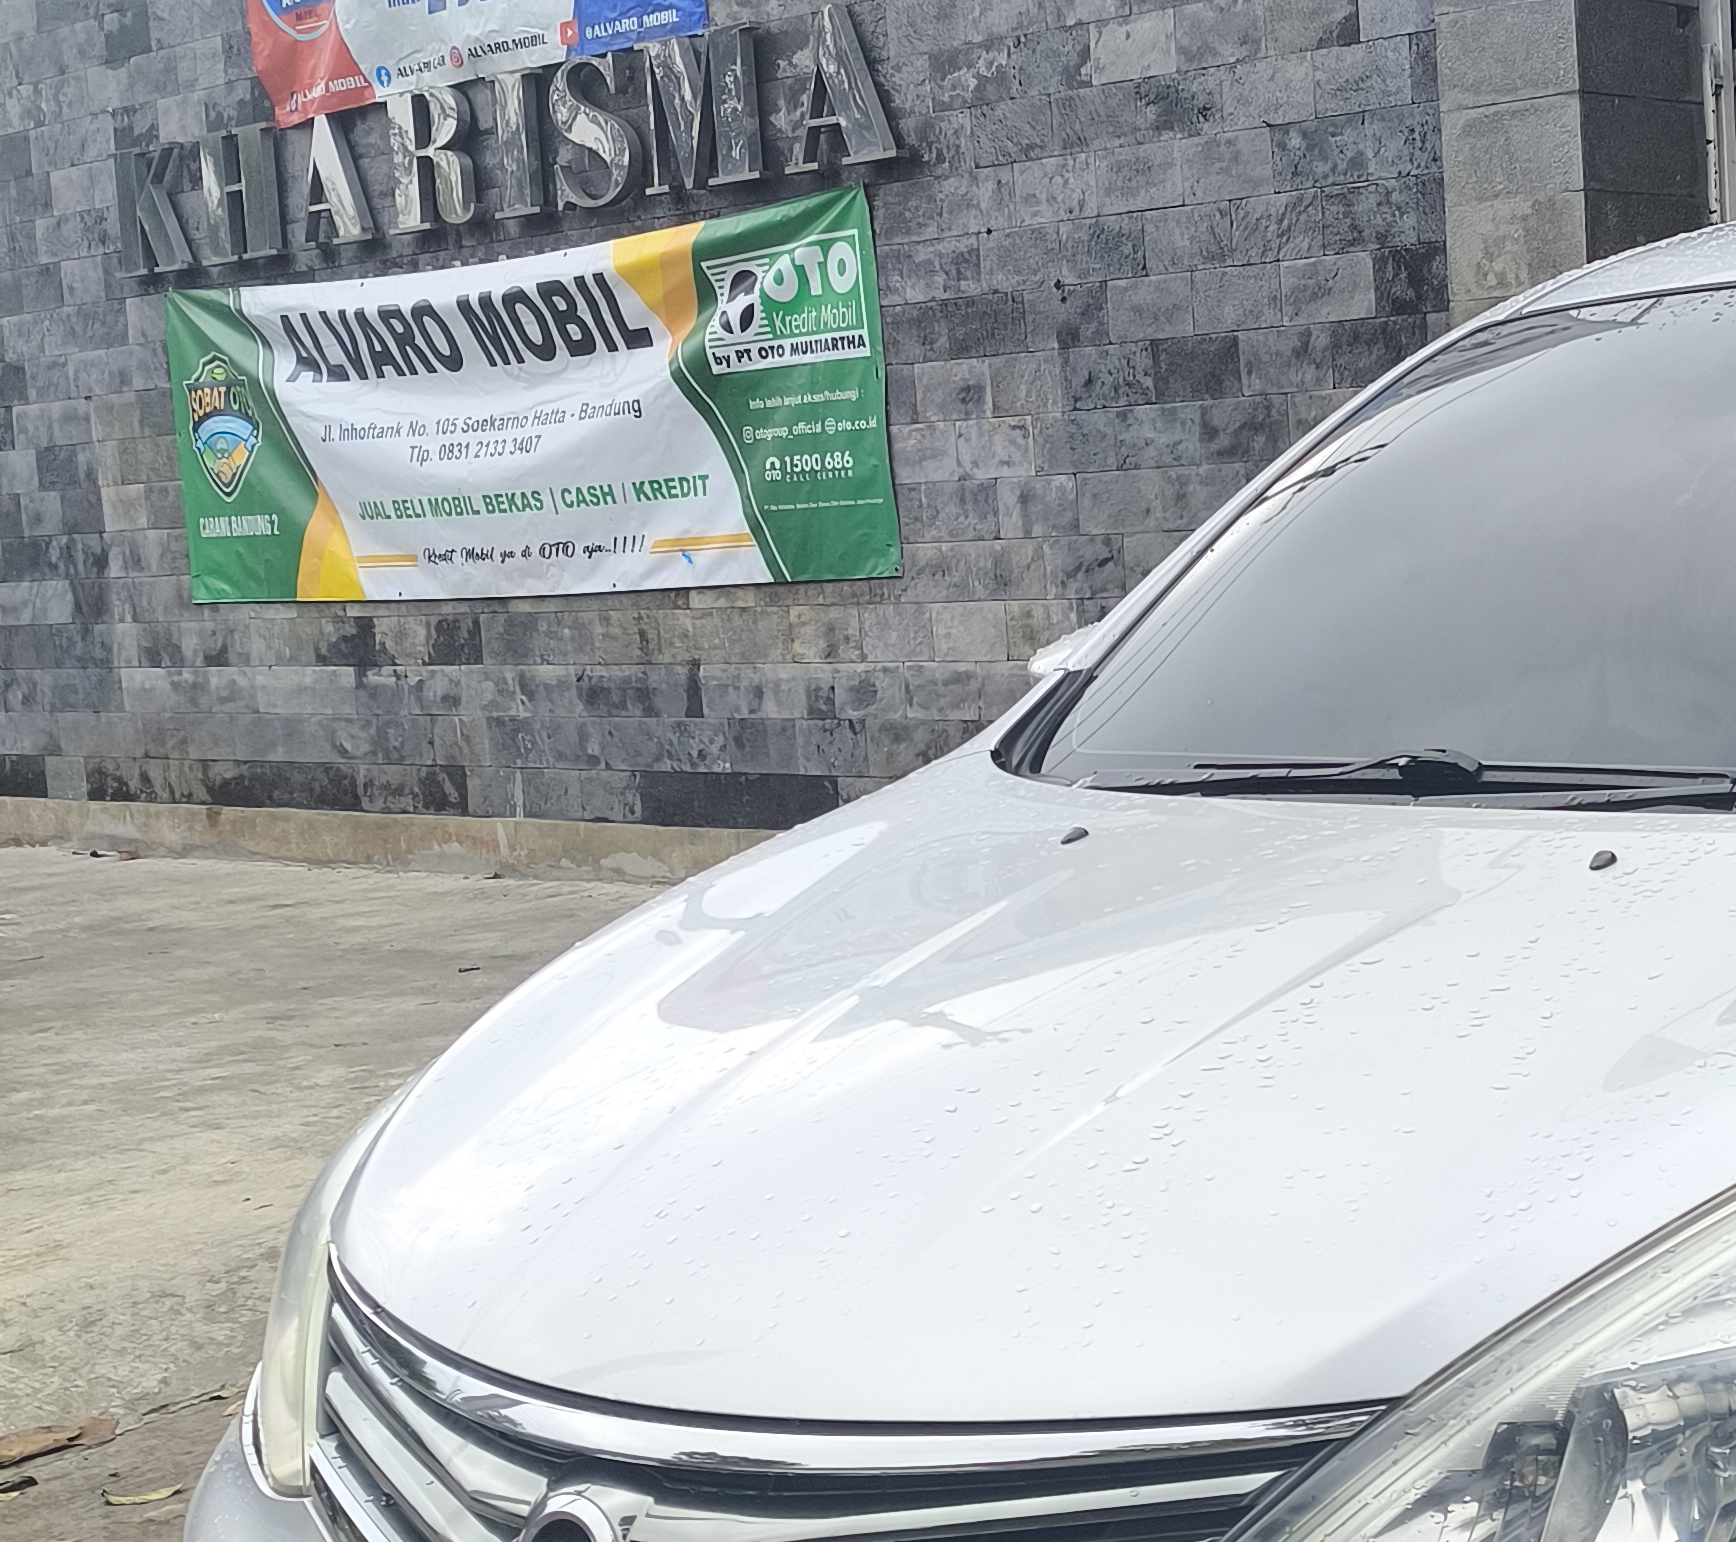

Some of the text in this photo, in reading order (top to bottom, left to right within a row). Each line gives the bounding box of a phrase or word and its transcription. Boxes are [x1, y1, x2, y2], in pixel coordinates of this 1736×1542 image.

[585, 9, 679, 40] @ALVARO_MOBIL
[112, 4, 898, 278] KHARISMA
[763, 241, 858, 303] OTO
[280, 272, 654, 383] ALVARO MOBIL
[772, 300, 857, 337] Kredit Mobil
[711, 334, 867, 369] by PT OTO MULTIARTHA
[320, 423, 335, 443] Jl.
[338, 420, 403, 442] Inhoftank
[406, 419, 430, 439] No.
[434, 416, 459, 437] 105
[460, 411, 529, 435] Soekarno
[578, 398, 642, 421] Bandung
[408, 435, 542, 467] Tlp. 0831 2133 3407
[785, 451, 854, 473] 1500 686
[765, 470, 781, 482] OTO
[359, 474, 710, 521] JUAL BELI MOBIL BEKAS CASH KREDIT
[272, 514, 280, 535] 2
[460, 546, 495, 565] Mobil
[538, 540, 576, 560] OTO
